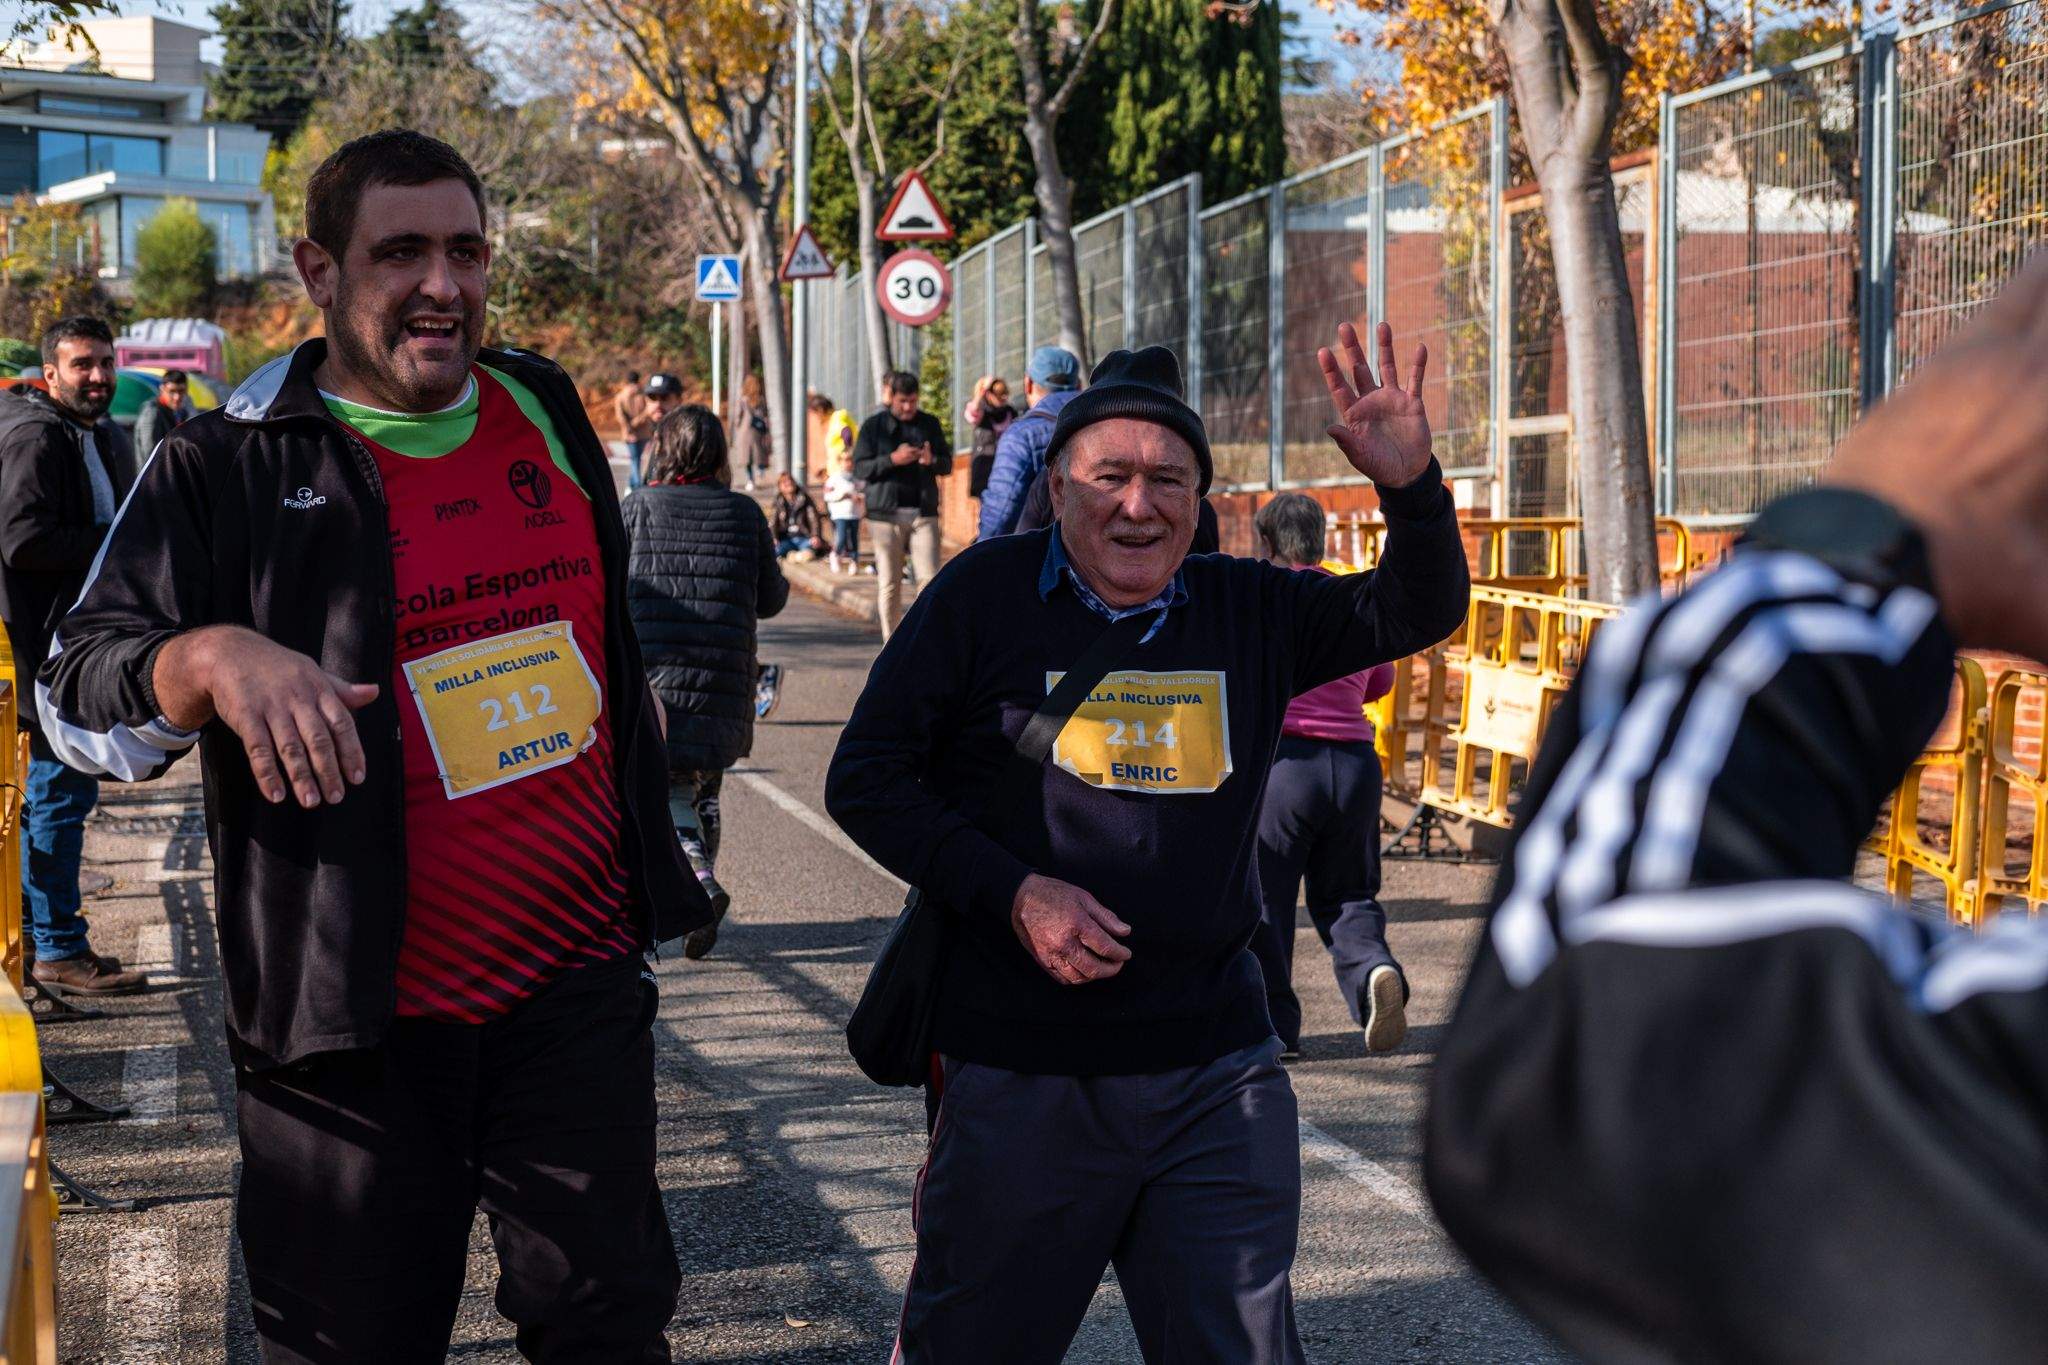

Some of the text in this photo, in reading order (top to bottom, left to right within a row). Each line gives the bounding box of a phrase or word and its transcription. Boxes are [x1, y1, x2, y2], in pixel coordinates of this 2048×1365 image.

[895, 277, 935, 298] 30
[284, 496, 326, 509] FORWARD
[394, 556, 592, 619] cola Esportiva
[405, 603, 560, 648] Barcelona
[504, 639, 516, 650] DE
[434, 650, 560, 694] MILLA INCLUSIVA
[1161, 676, 1216, 685] VALLDOREIX
[480, 684, 558, 732] 212
[1084, 692, 1203, 706] LLA INCLUSIVA
[1104, 718, 1179, 749] 214
[498, 731, 573, 769] ARTUR
[1111, 762, 1179, 782] ENRIC
